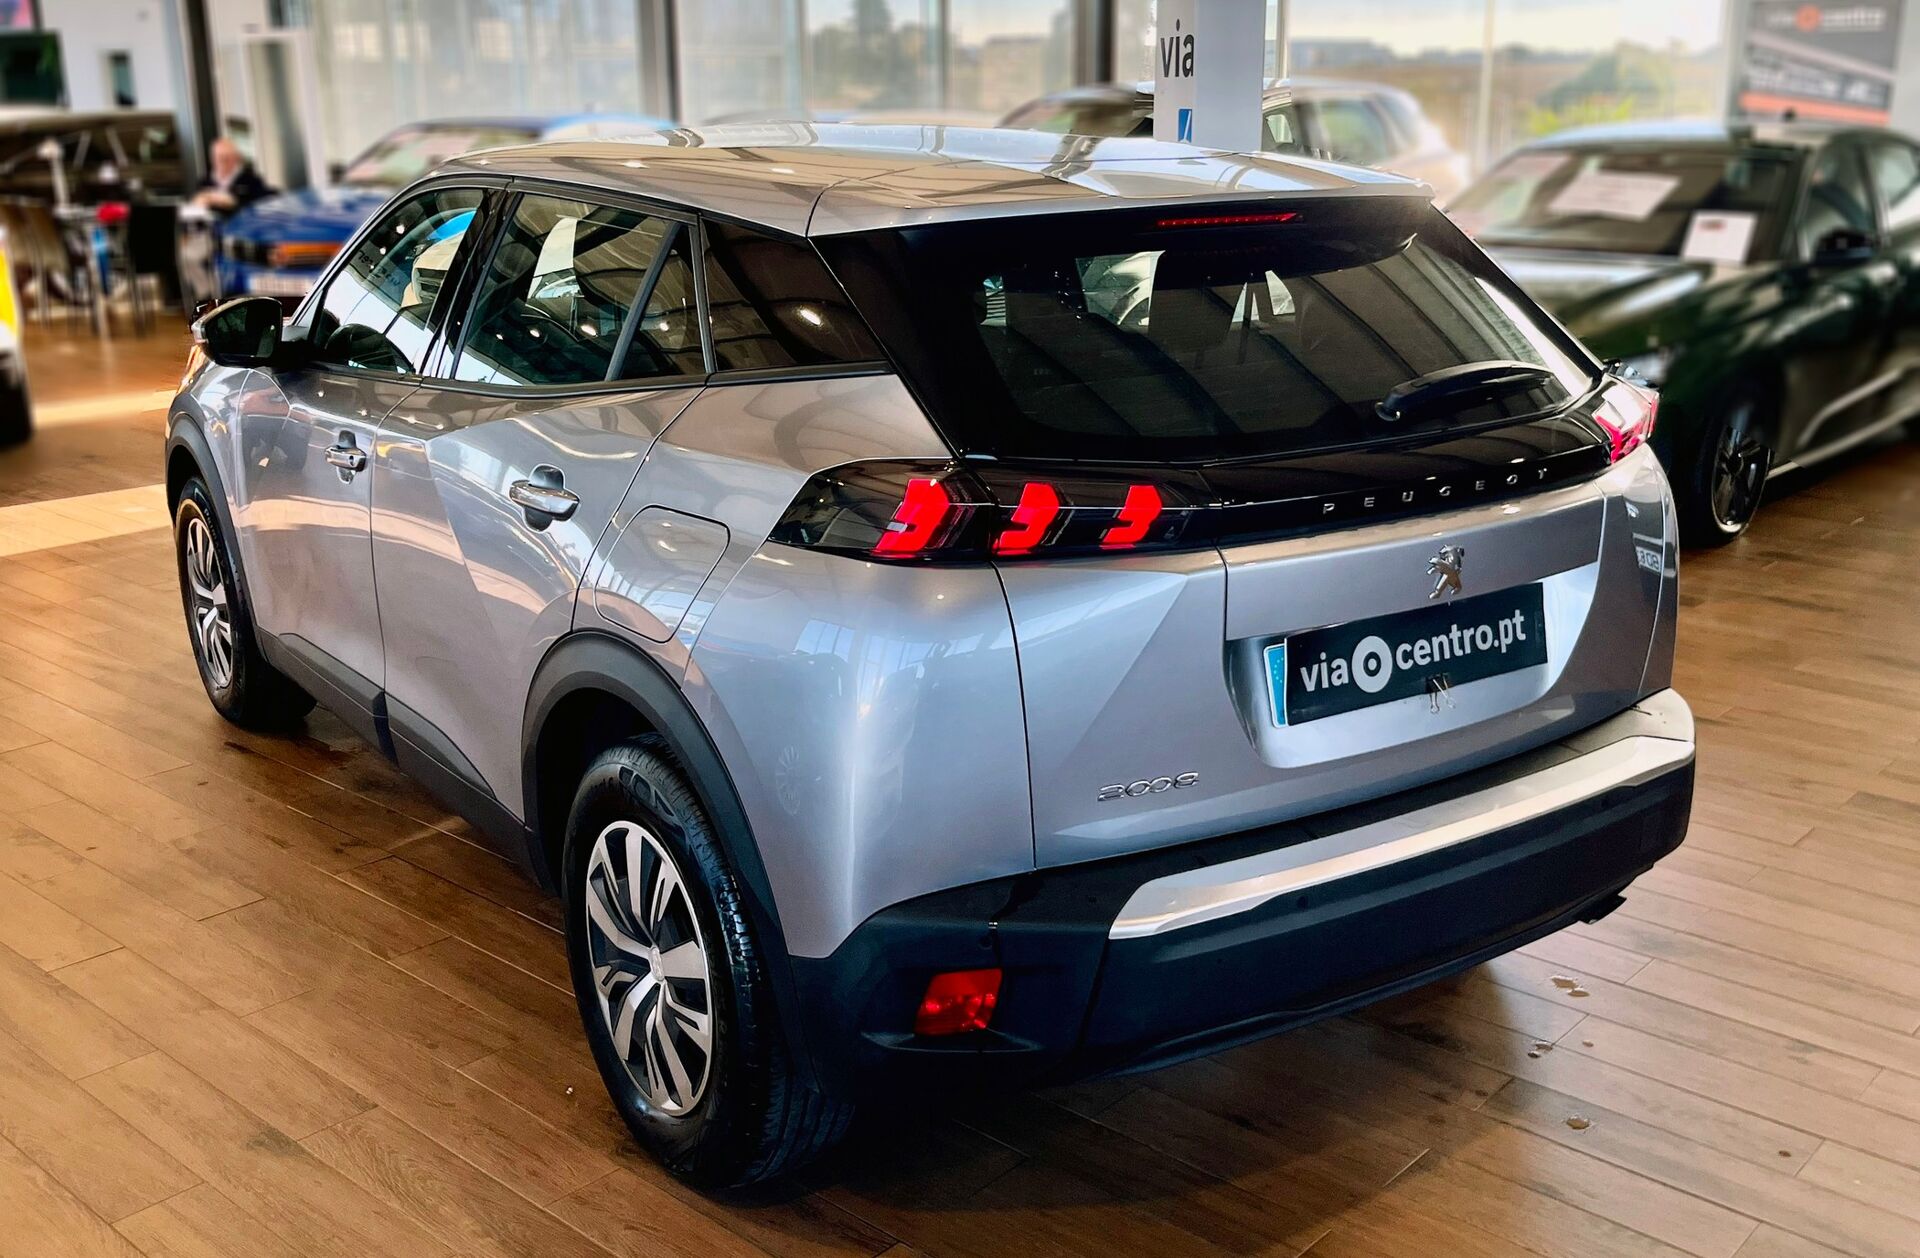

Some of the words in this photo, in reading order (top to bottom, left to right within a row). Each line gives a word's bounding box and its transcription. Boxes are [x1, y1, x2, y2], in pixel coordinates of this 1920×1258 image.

[1160, 18, 1195, 78] via
[1322, 467, 1548, 515] PEUGEOT
[1300, 651, 1350, 693] via
[1395, 608, 1527, 671] centro.pt
[1097, 770, 1200, 802] 2008
